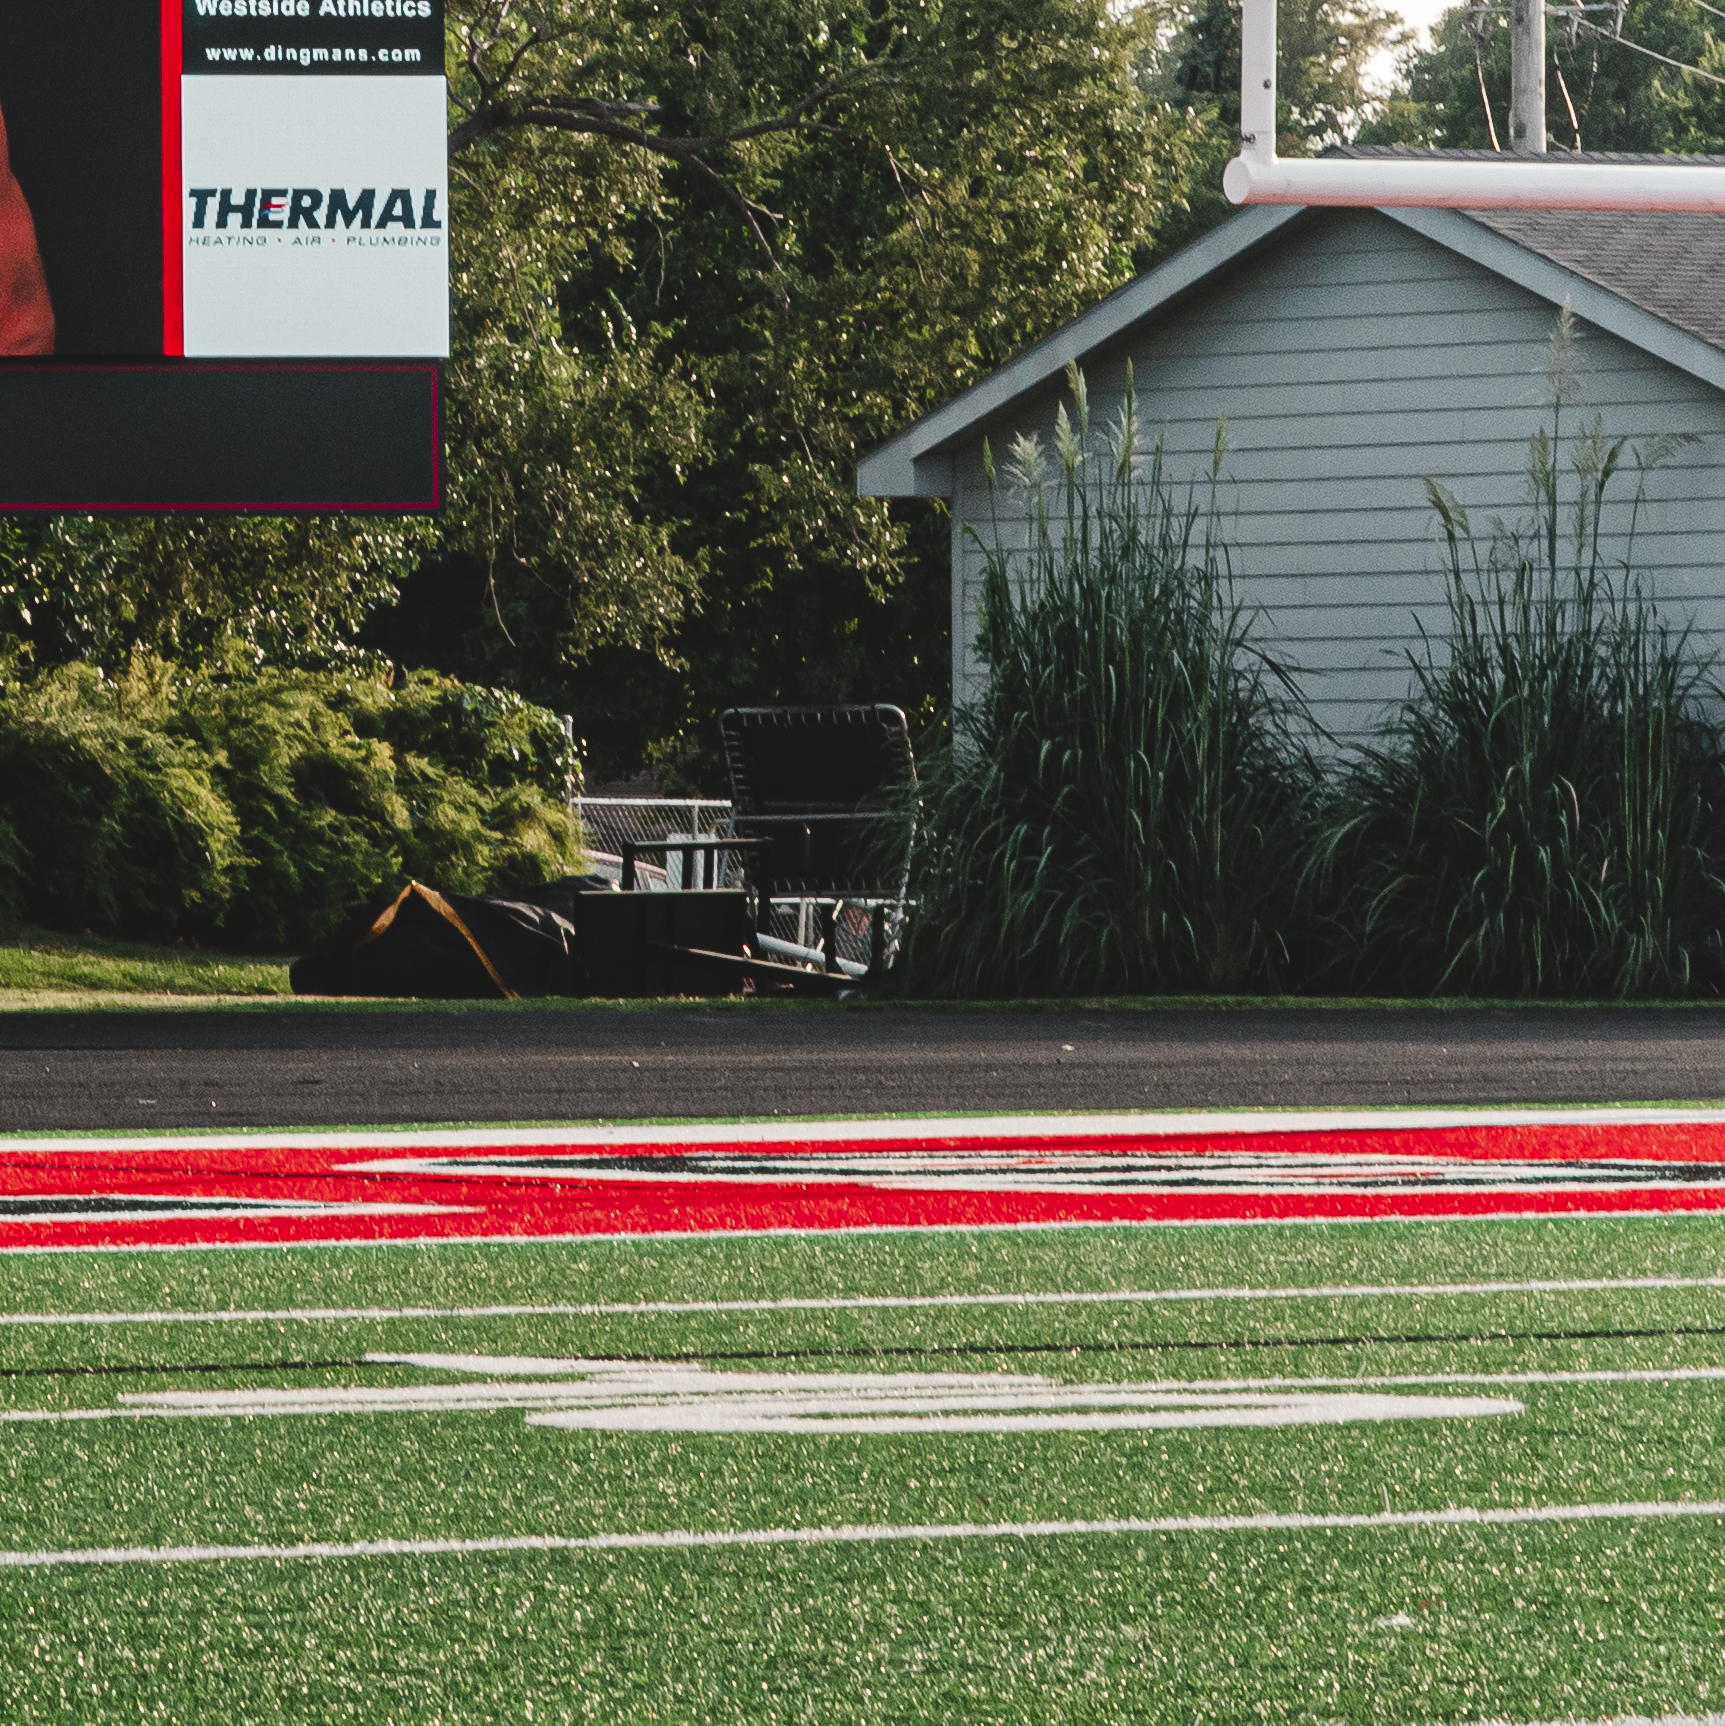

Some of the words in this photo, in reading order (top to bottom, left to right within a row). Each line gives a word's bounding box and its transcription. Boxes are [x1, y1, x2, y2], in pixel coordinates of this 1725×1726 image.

[205, 44, 421, 67] www.dingmans.com
[189, 188, 442, 230] THERMAL
[189, 235, 267, 246] HEATING
[291, 235, 322, 246] AIR
[346, 235, 442, 247] PLUMBING
